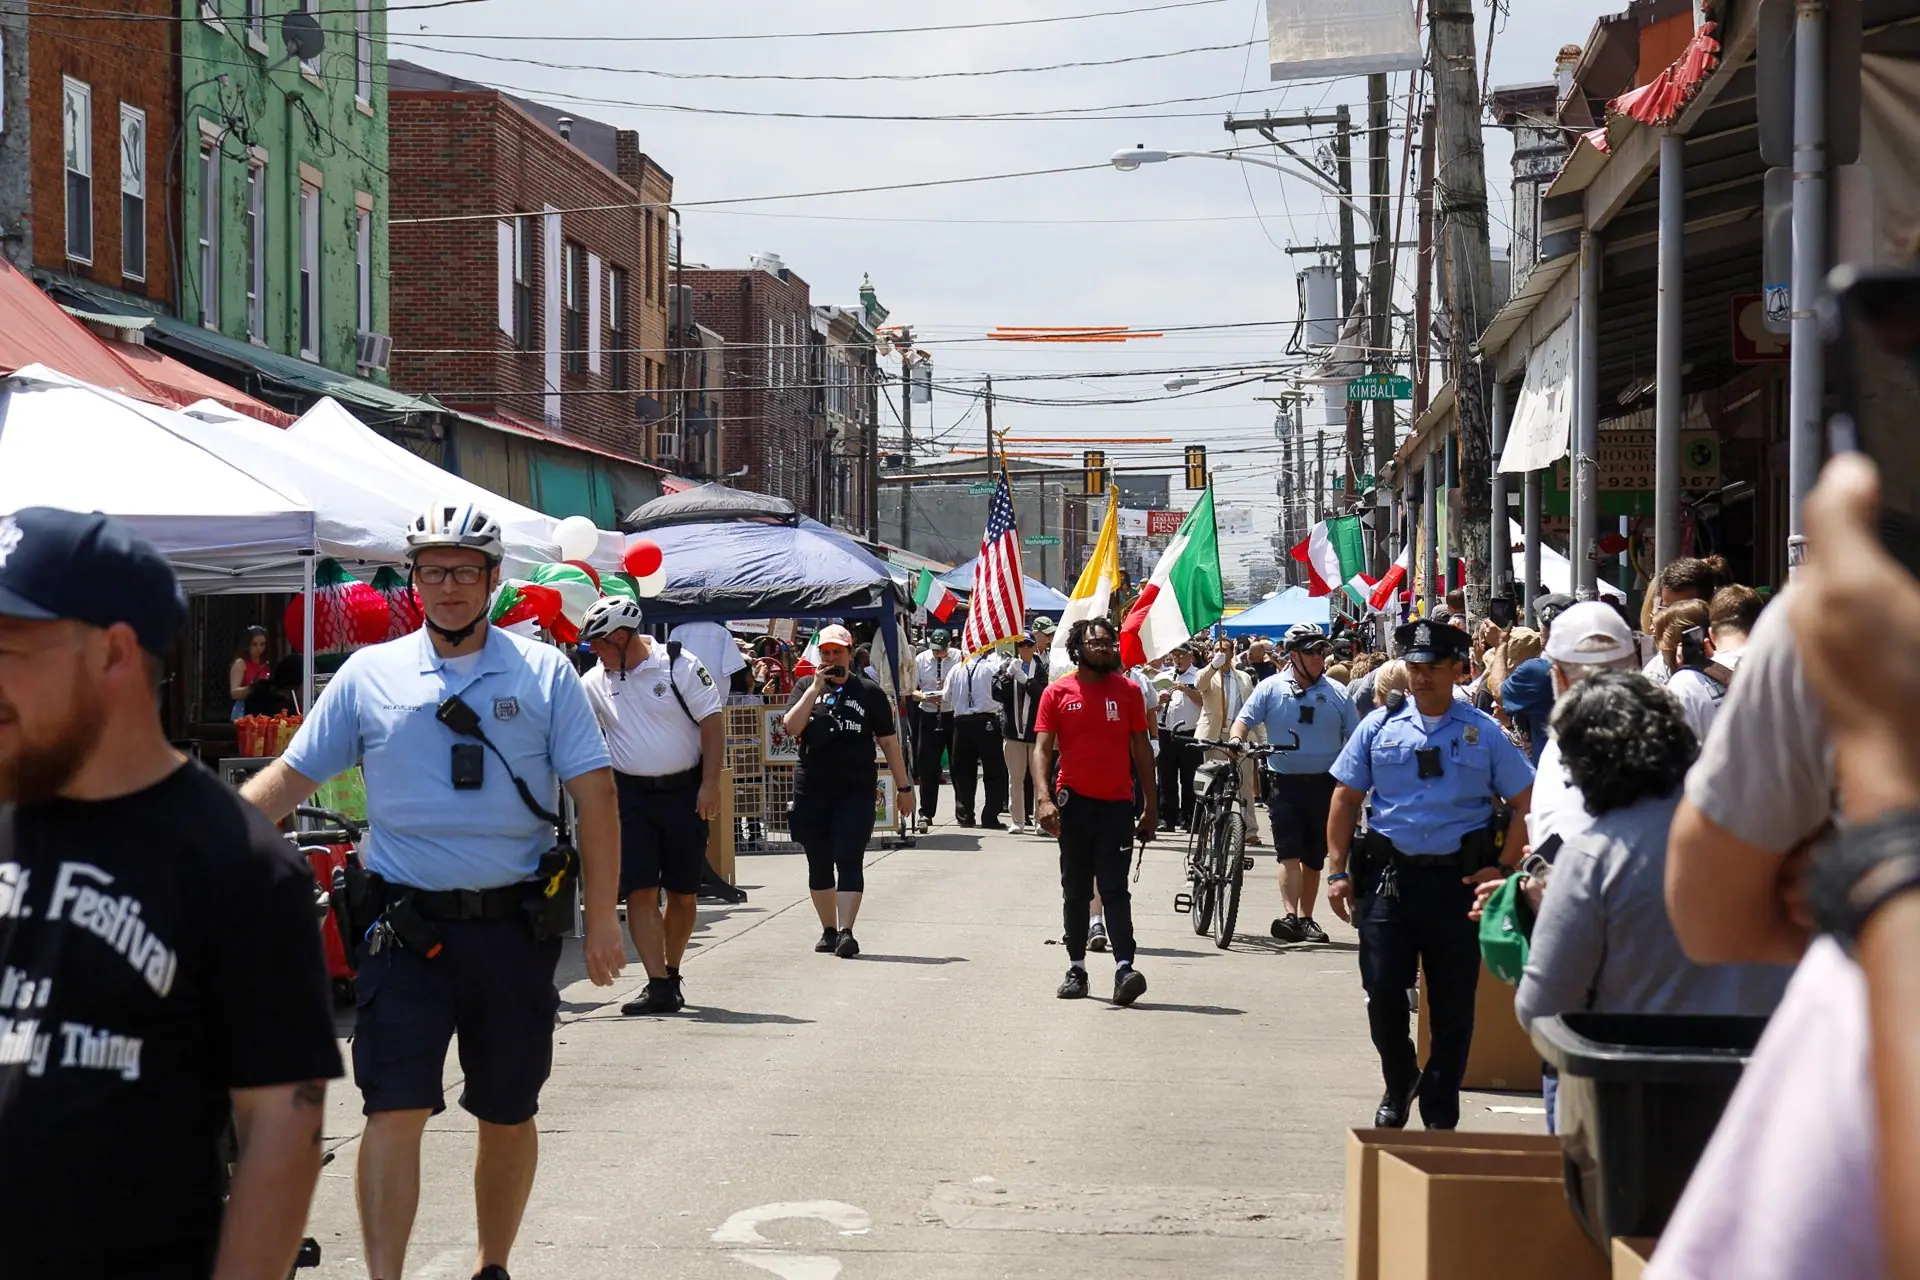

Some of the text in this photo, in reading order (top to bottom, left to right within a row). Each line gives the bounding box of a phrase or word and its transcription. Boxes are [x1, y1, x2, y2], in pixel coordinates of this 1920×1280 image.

[1349, 384, 1398, 398] KIMBALL
[1598, 435, 1656, 444] MOLL
[1596, 464, 1656, 475] RECOR
[1562, 476, 1717, 488] 2-923-367
[969, 486, 997, 495] Washing
[1152, 521, 1182, 533] FEST
[1067, 702, 1082, 711] 119
[845, 719, 862, 733] Thing
[46, 860, 178, 998] Festival
[0, 1015, 144, 1081] hilly Thing
